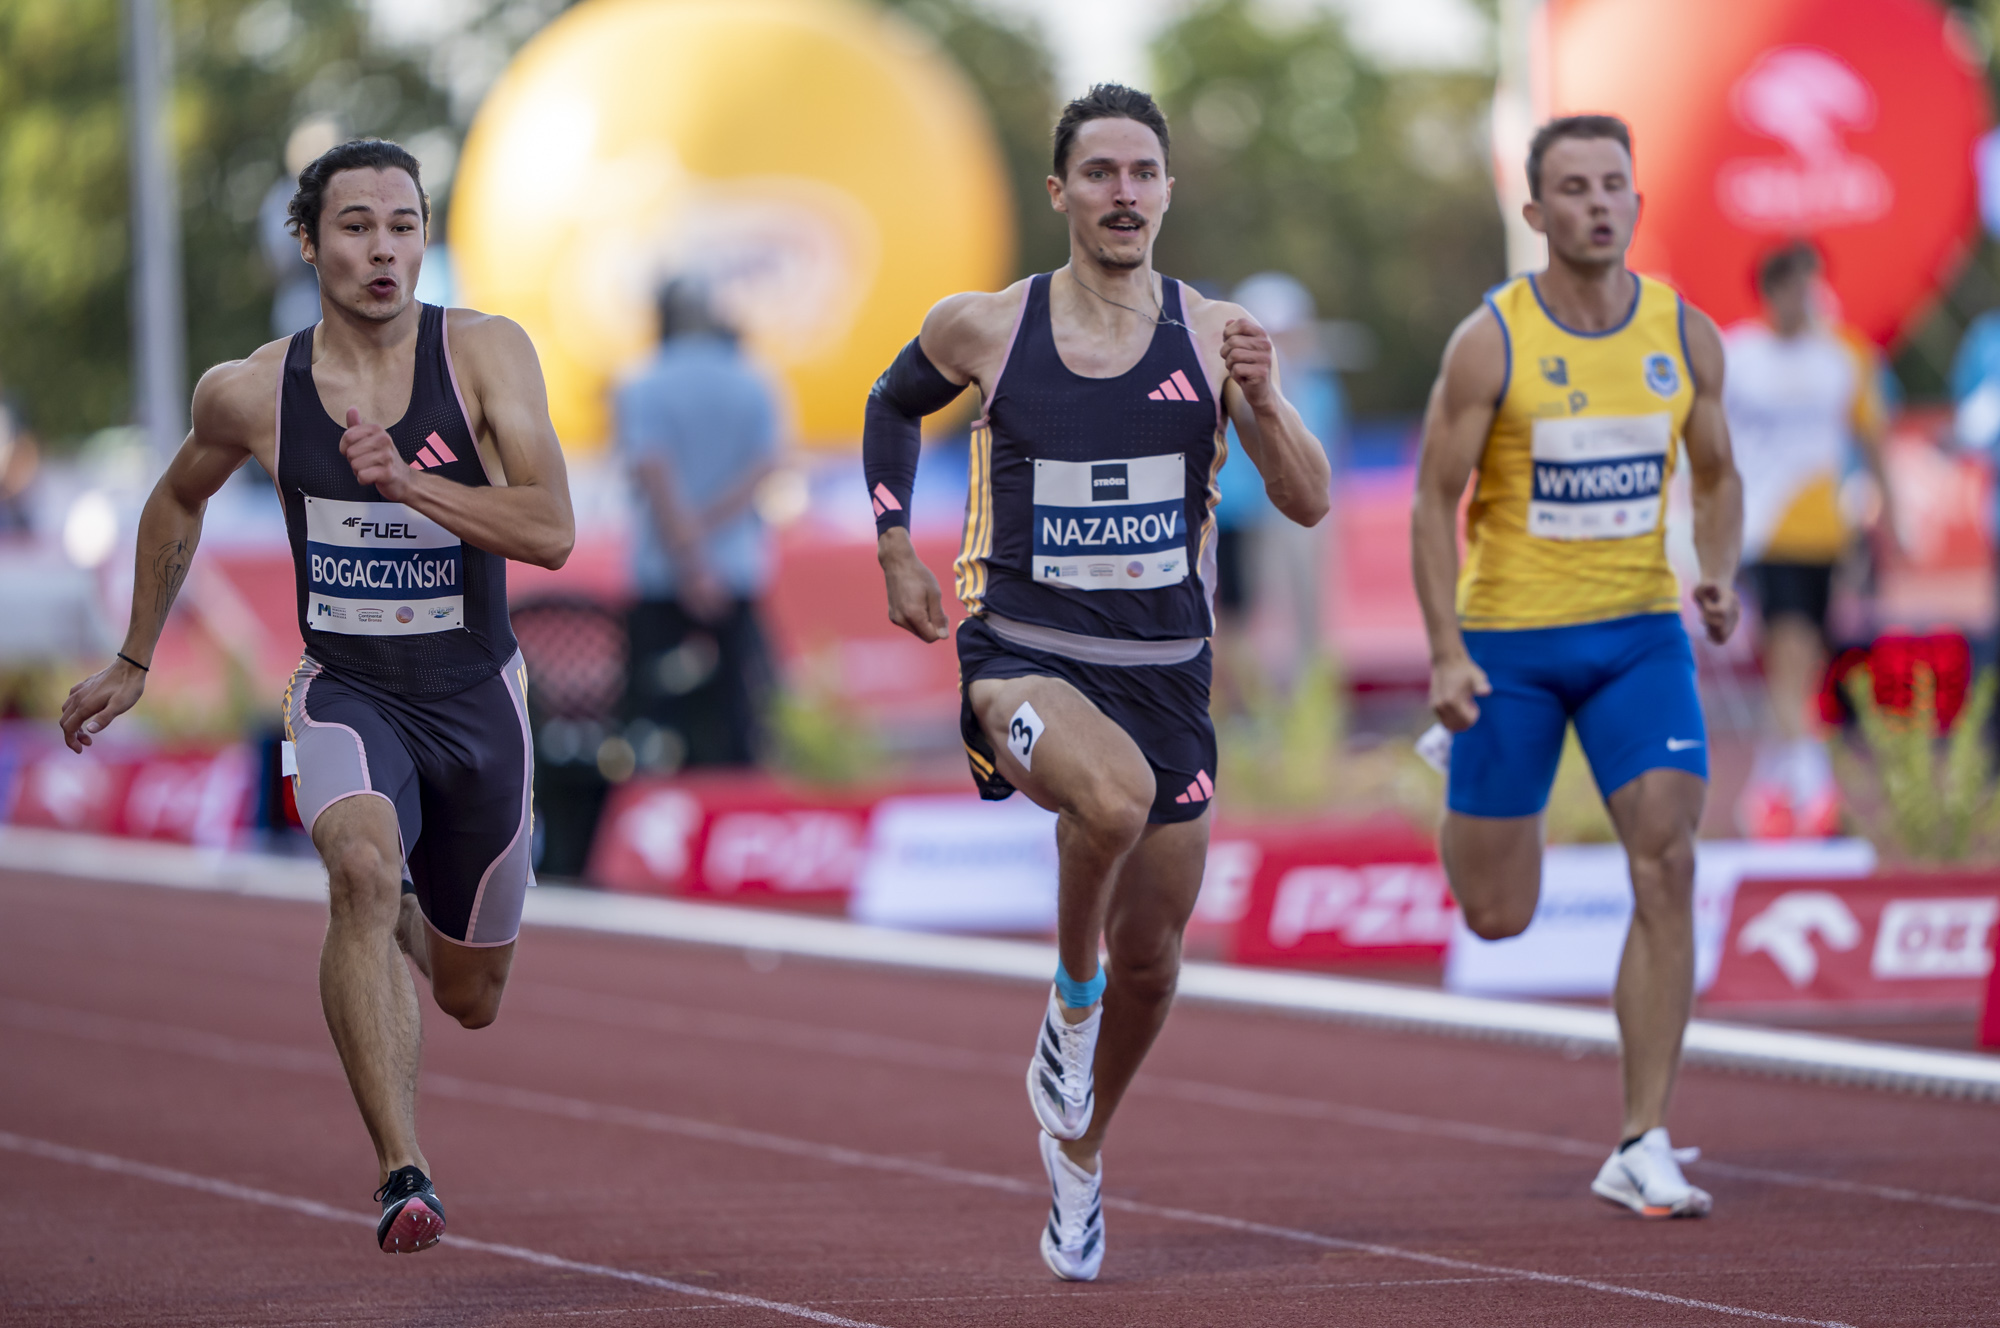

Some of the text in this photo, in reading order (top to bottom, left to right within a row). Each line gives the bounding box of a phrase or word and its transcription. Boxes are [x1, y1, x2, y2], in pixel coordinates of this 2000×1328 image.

[1093, 477, 1126, 487] STRÖER
[1537, 461, 1661, 498] WYKROTA
[342, 517, 418, 539] 4F FUEL
[1042, 510, 1178, 546] NAZAROV
[311, 553, 456, 589] BOGACZYŃSKI
[1011, 716, 1034, 756] 3
